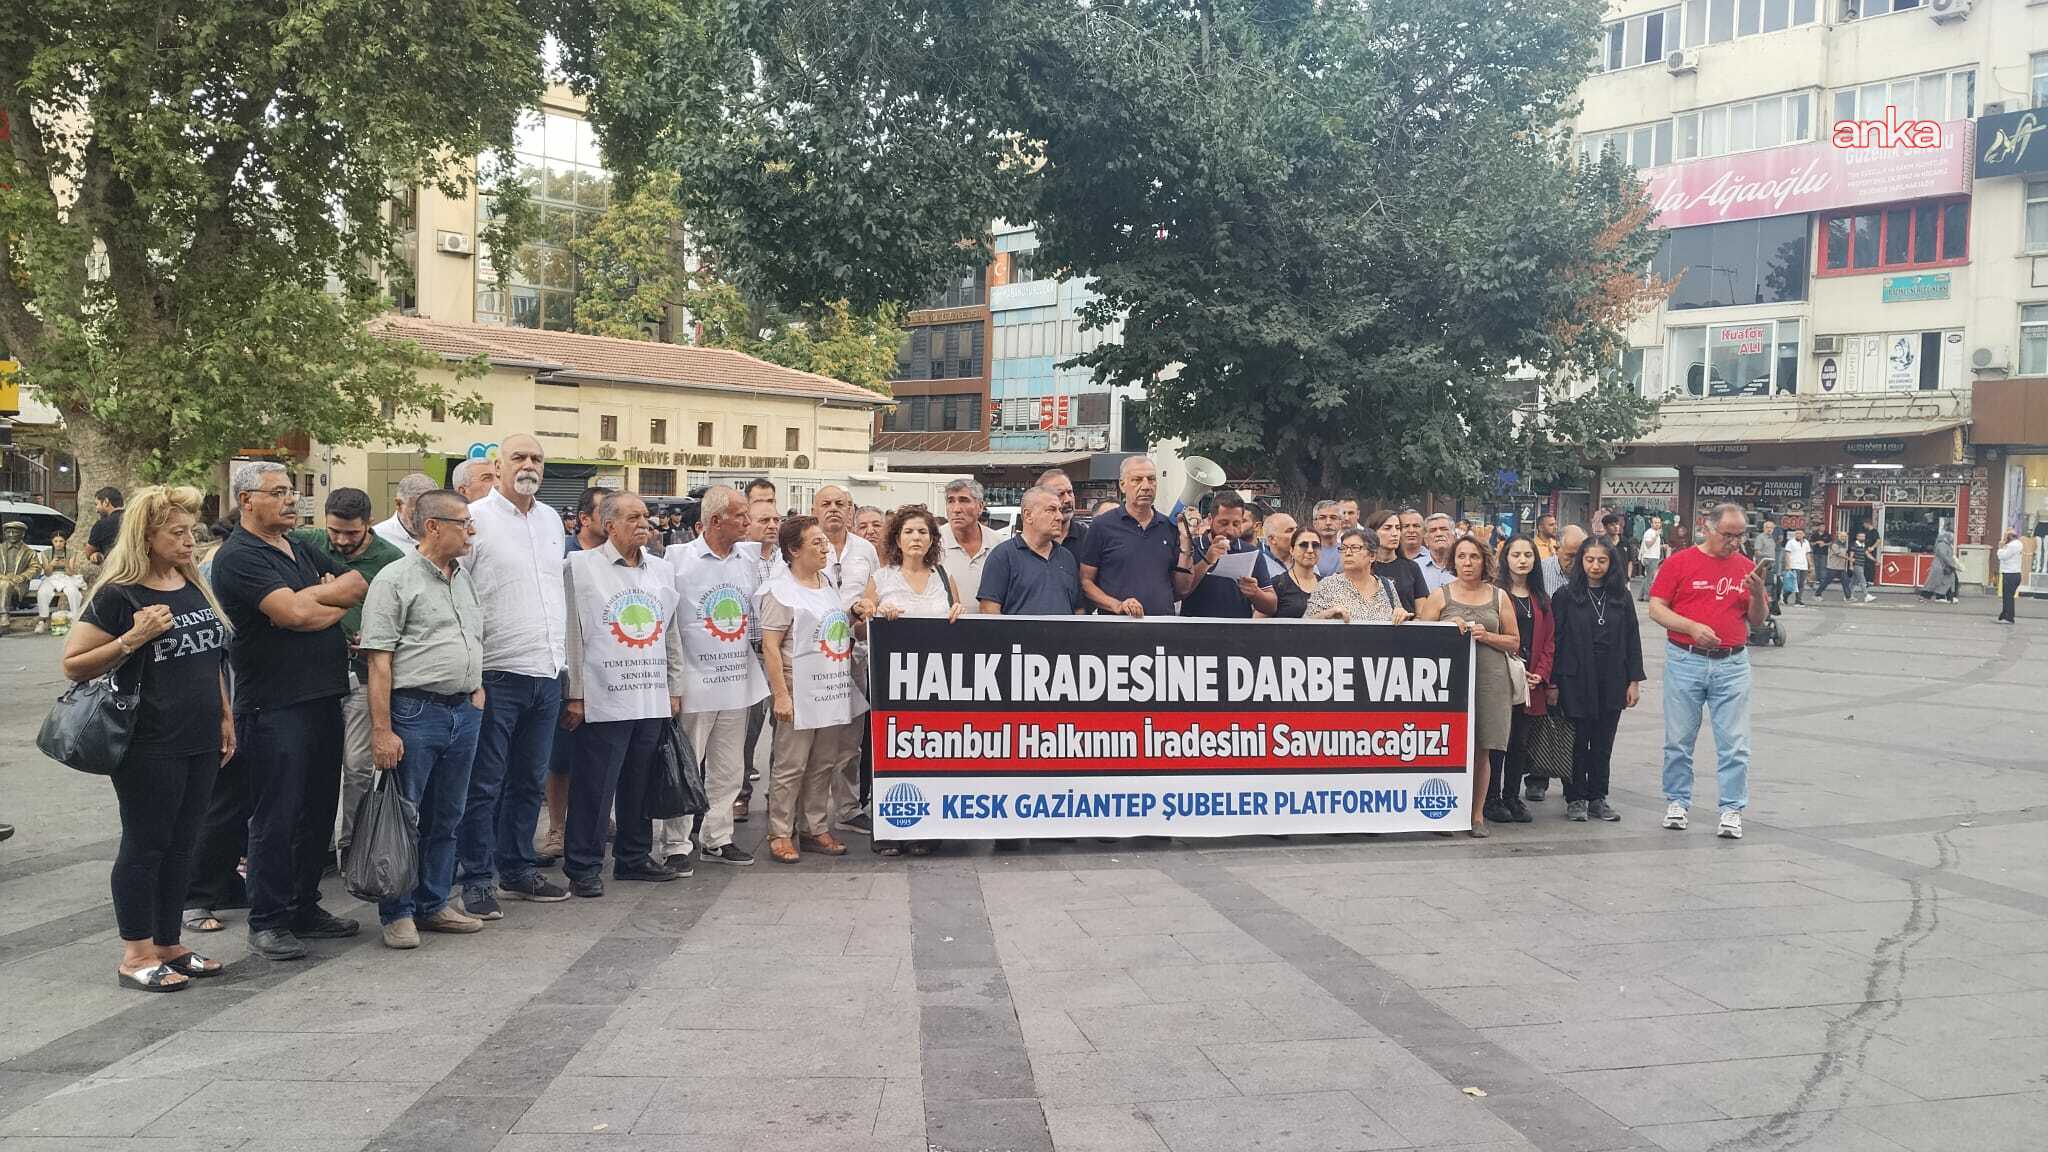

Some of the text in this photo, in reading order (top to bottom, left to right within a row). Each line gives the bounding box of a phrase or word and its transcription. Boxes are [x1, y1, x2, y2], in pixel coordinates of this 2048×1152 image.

[1687, 158, 1832, 216] Ağaoğlu
[1698, 486, 1743, 496] AMBAR
[888, 644, 1452, 702] HALK İRADESİNE DARBE VAR!
[887, 717, 1451, 762] İstanbul Halkının İradesini Savunacağız!
[879, 802, 930, 816] KESK
[942, 788, 1408, 821] KESK GAZİANTEP ŞUBELER PLATFORMU
[1413, 796, 1459, 809] KESK
